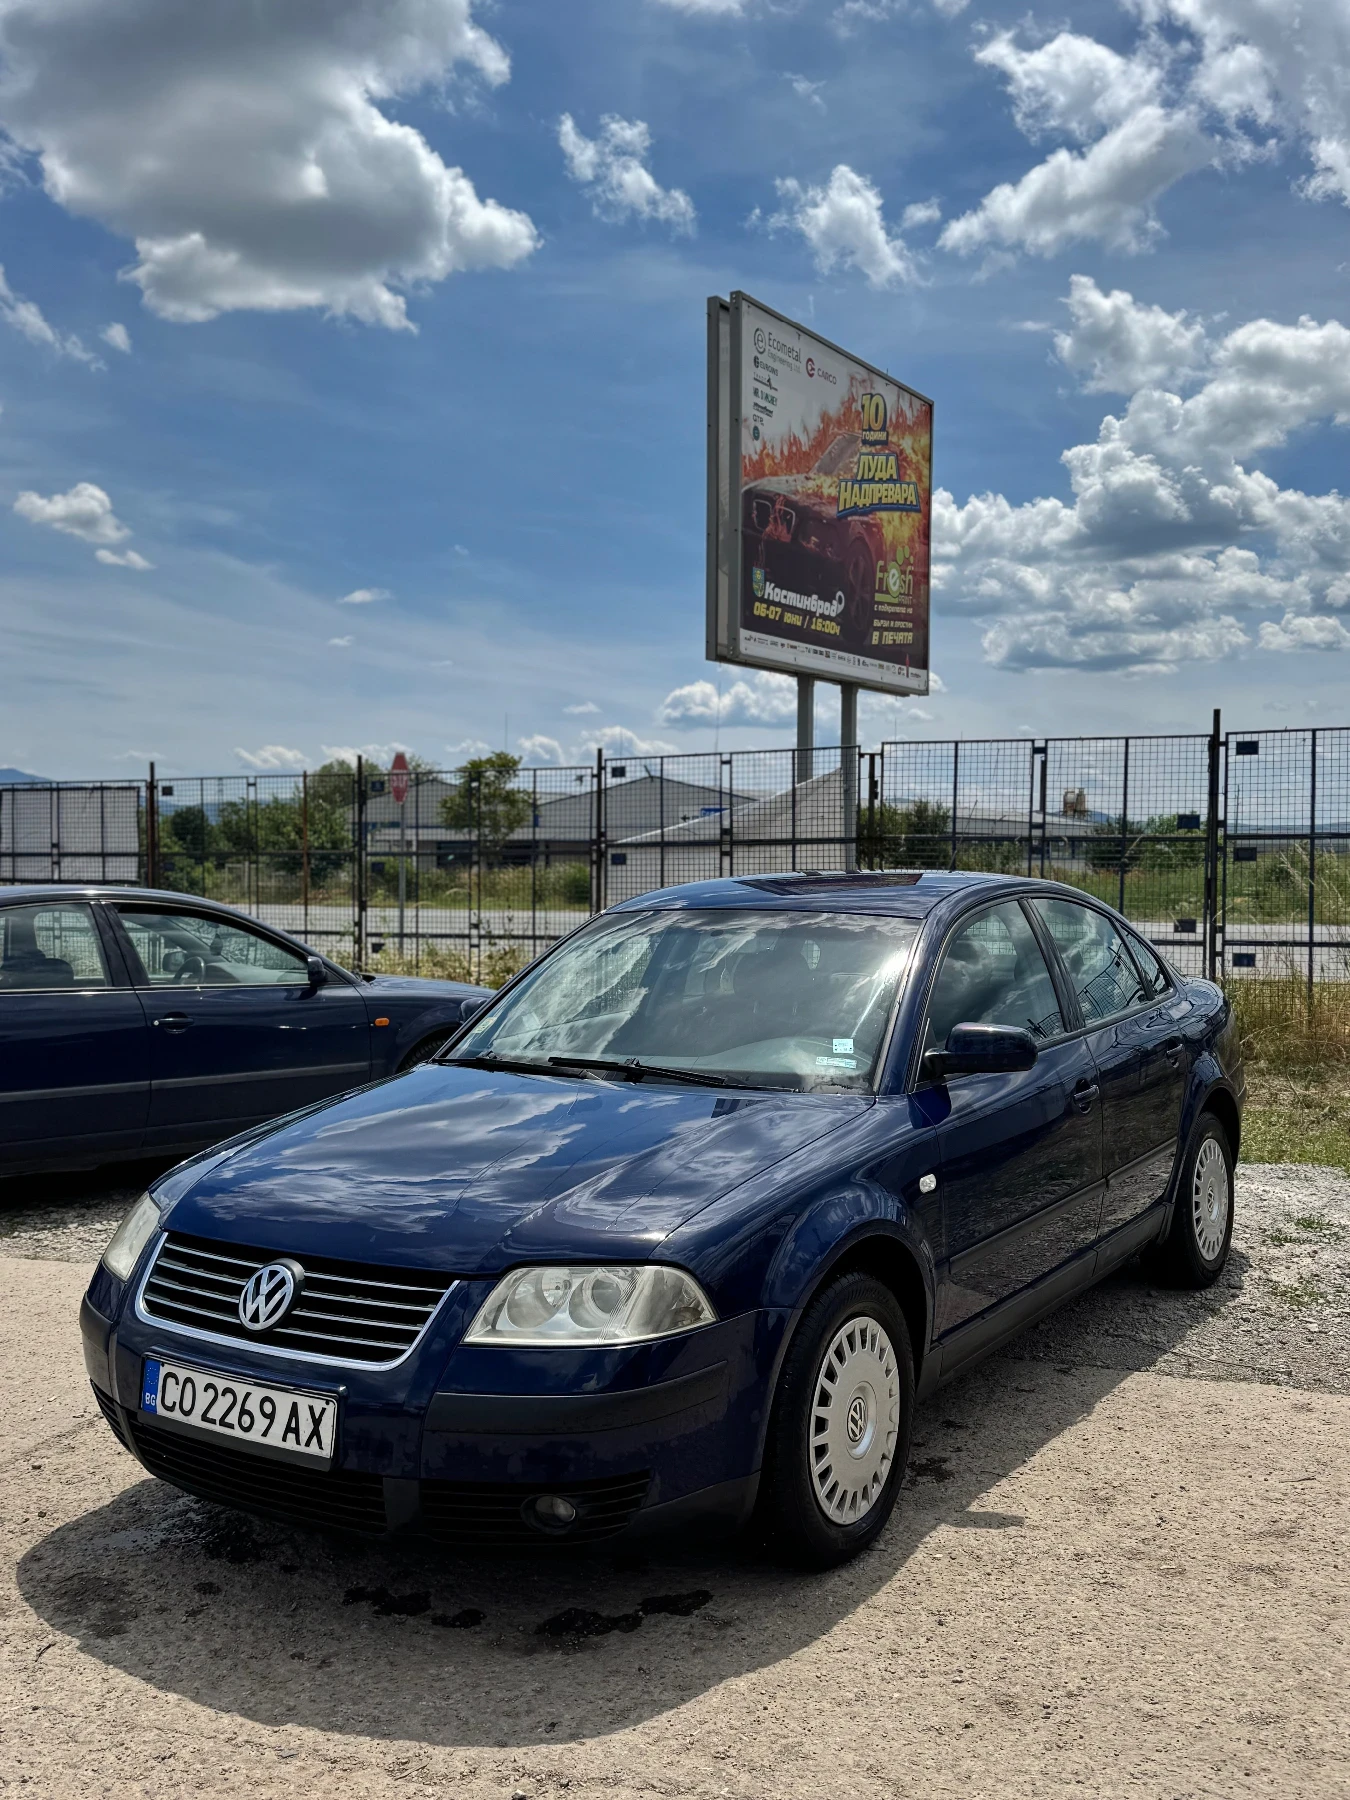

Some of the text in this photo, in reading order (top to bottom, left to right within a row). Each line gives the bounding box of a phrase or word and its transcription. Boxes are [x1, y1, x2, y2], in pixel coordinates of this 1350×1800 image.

[768, 332, 802, 363] Ecometal
[817, 368, 837, 385] CARCO
[862, 393, 885, 431] 10
[857, 455, 897, 480] ЛУДА
[838, 481, 917, 511] НАДПРЕВАРА
[753, 601, 782, 620] 06-07
[764, 581, 838, 617] Костинброд
[871, 631, 913, 645] В ПЕЧАТА
[145, 1391, 156, 1406] BG
